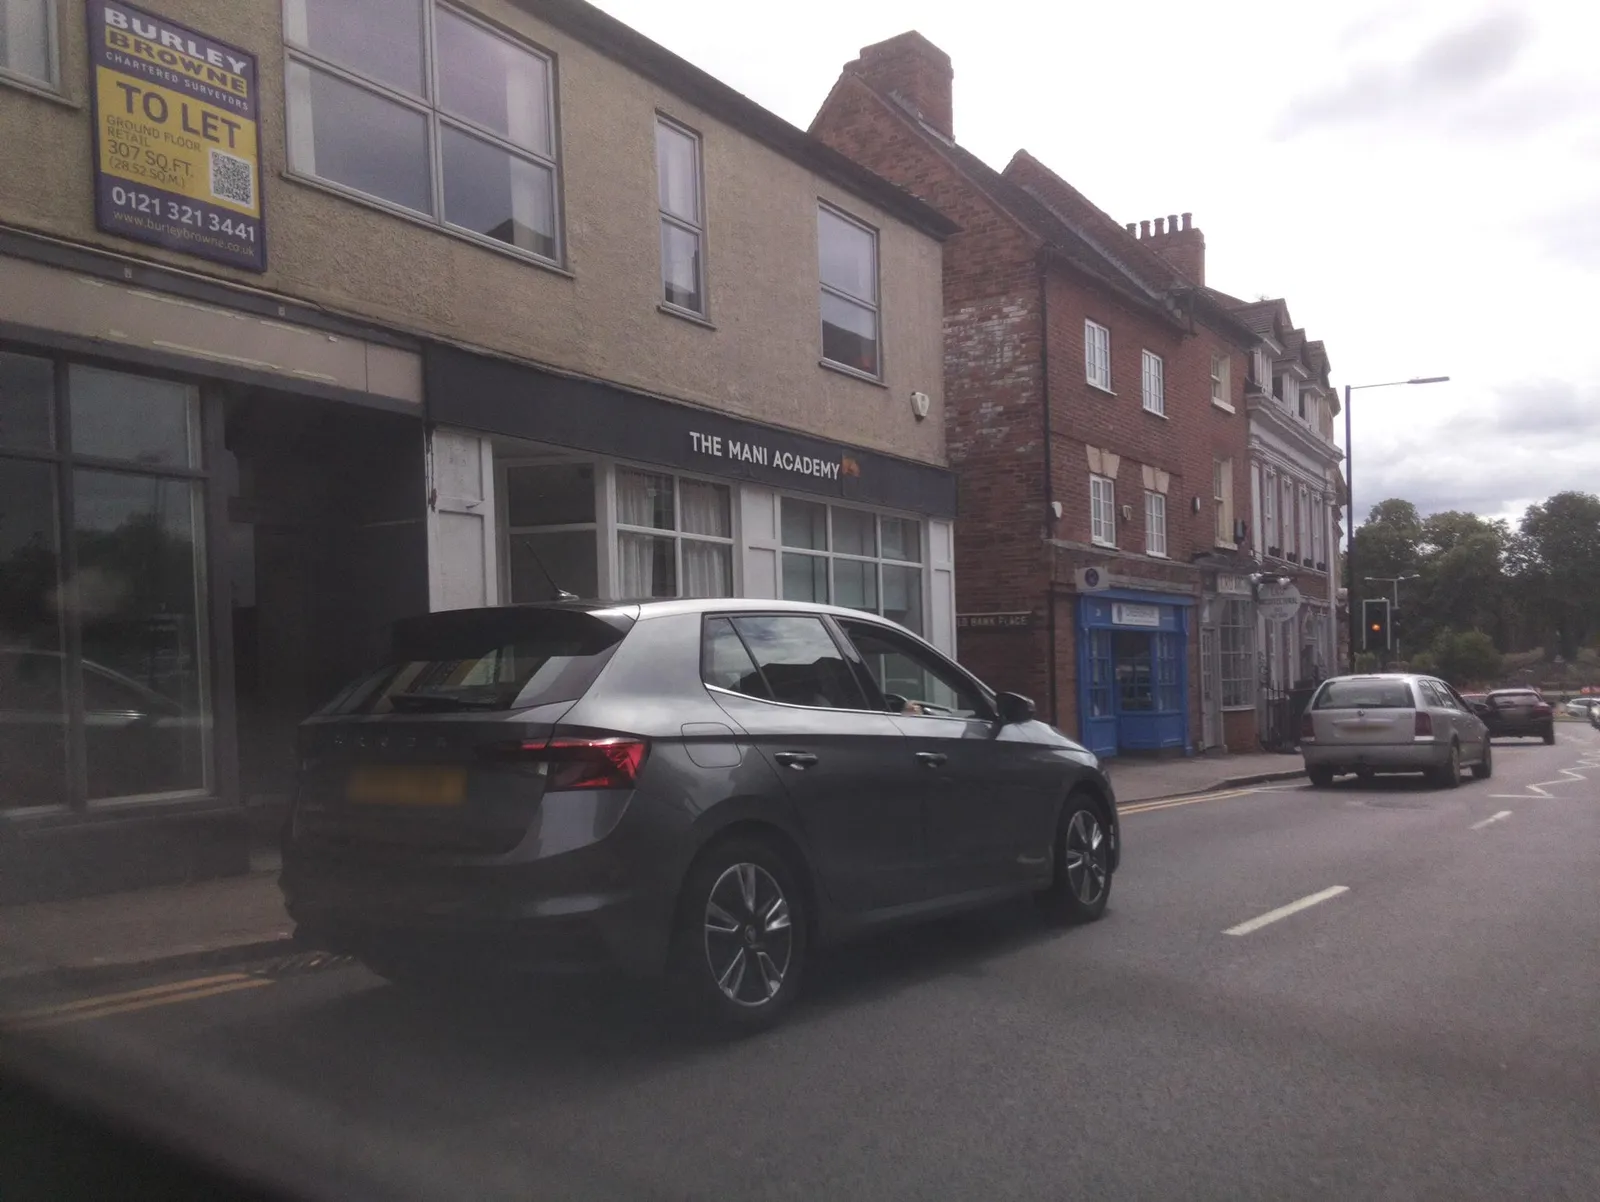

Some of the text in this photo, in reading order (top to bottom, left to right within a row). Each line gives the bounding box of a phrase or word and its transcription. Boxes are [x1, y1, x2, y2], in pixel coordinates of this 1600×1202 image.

[104, 7, 247, 75] BURLEY
[109, 30, 245, 94] BROWNE
[106, 51, 249, 112] CHARTERED SURVEYORS
[106, 114, 202, 152] GROUND FLOOR
[107, 125, 151, 148] RETAIL
[116, 81, 241, 148] TO LET
[107, 139, 194, 178] 307 SQ.FT.
[112, 186, 255, 242] 0121 321 3441
[113, 210, 255, 257] www.burleybrowne.co.uk
[689, 431, 841, 481] THE MANI ACADEMY
